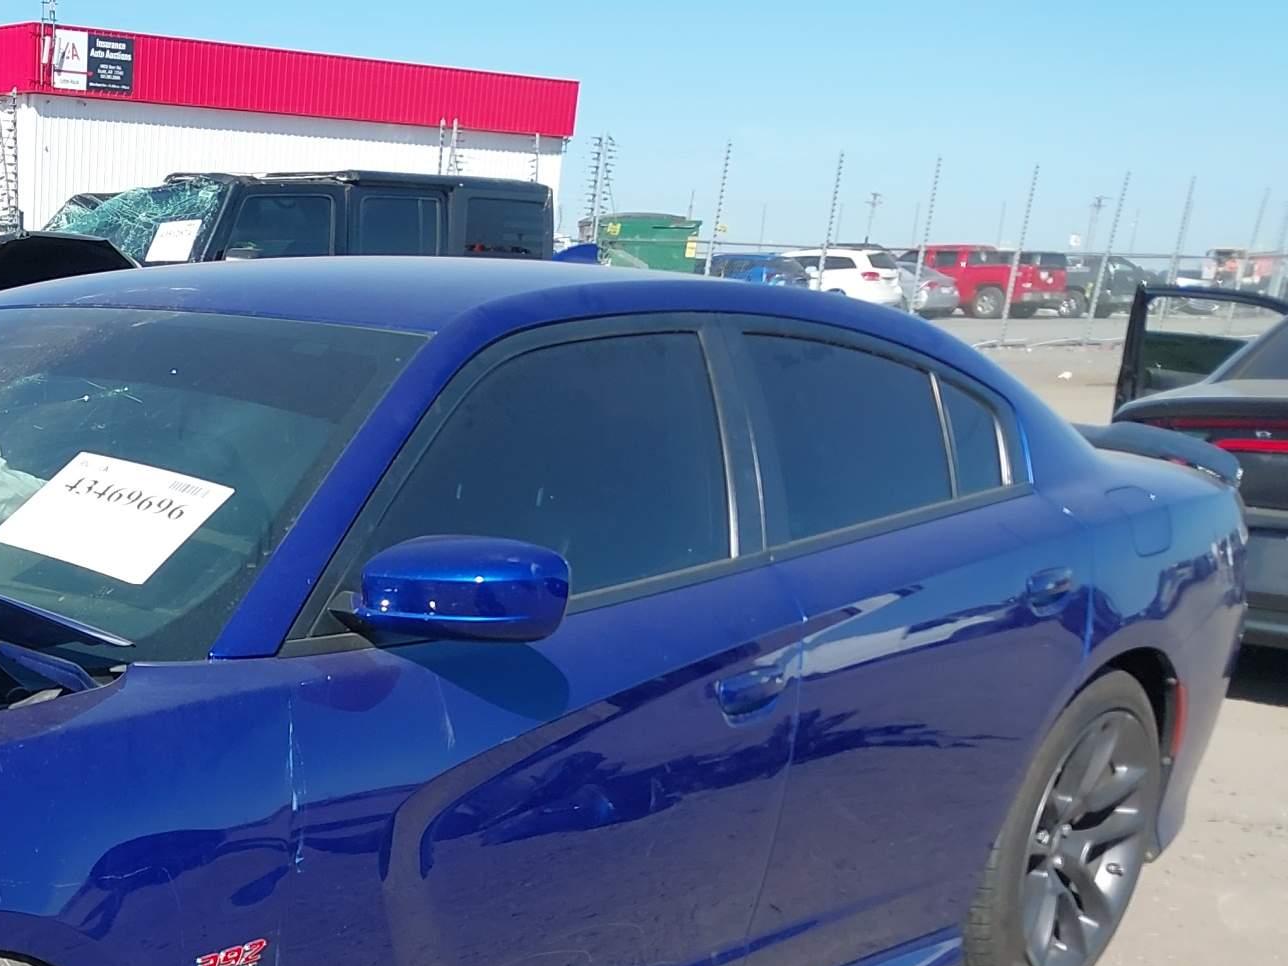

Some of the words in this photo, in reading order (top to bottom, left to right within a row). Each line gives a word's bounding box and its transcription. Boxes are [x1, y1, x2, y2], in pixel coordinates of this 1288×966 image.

[90, 48, 105, 59] Auto
[105, 49, 132, 61] Auctions
[65, 477, 190, 521] 43469696
